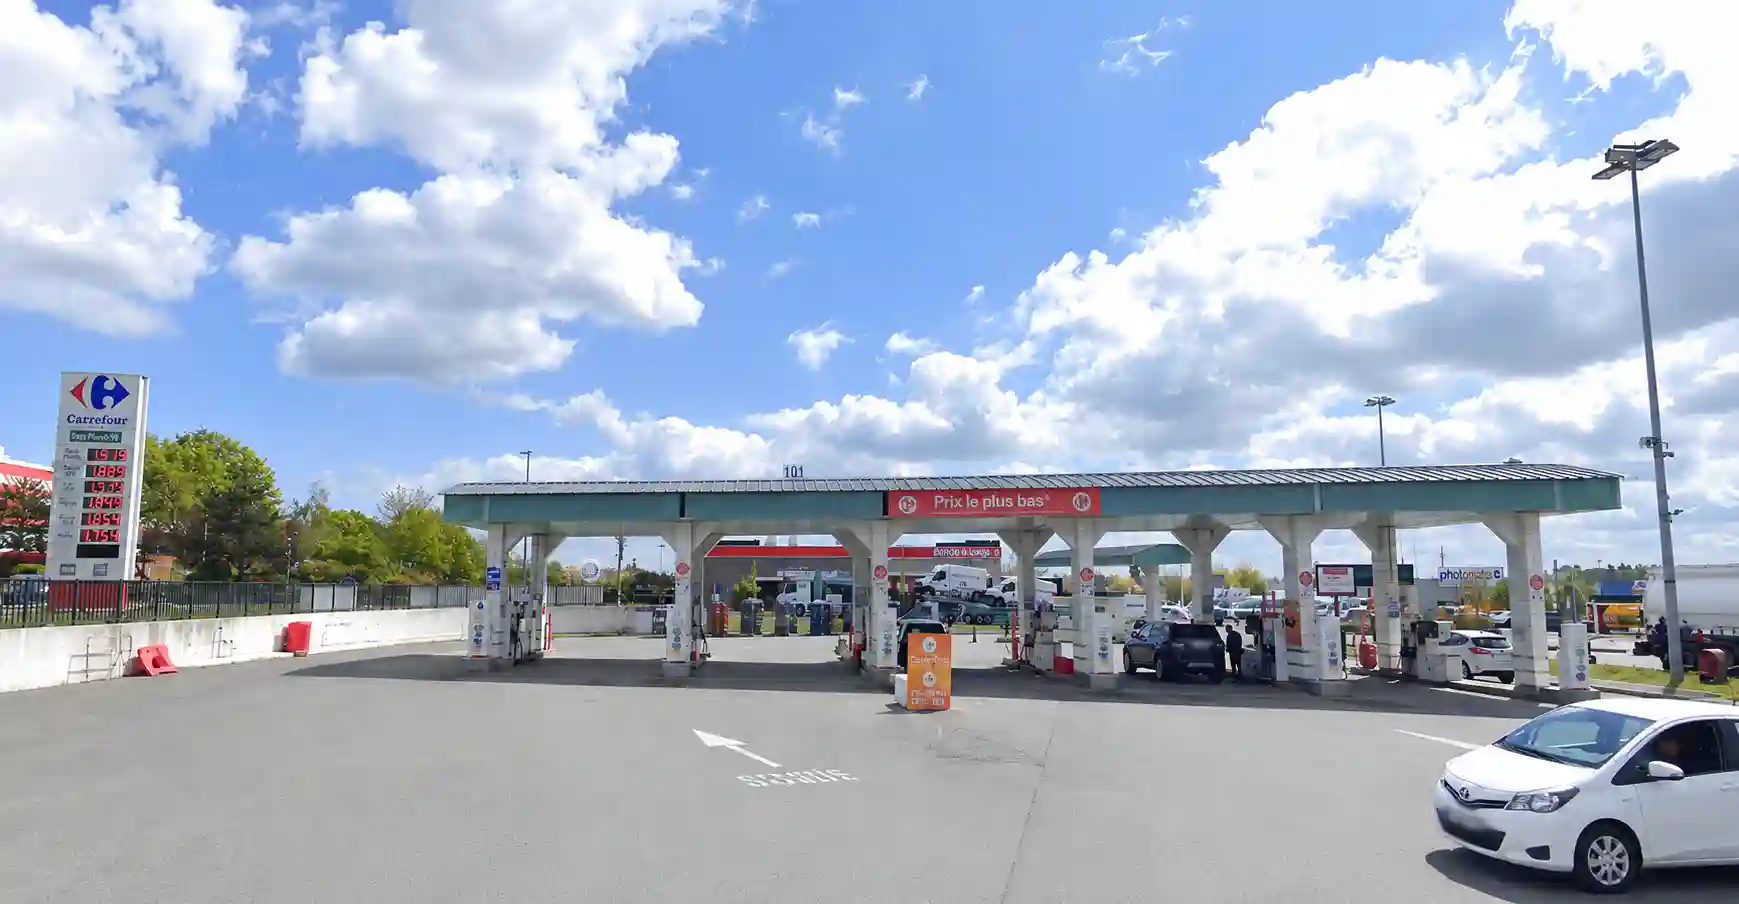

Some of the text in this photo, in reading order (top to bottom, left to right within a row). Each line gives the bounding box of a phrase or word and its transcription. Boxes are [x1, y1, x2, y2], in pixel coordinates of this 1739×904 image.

[67, 413, 129, 426] Carrefour
[783, 465, 804, 478] 101
[934, 495, 963, 509] Prix
[966, 494, 978, 508] le
[982, 494, 1013, 511] plus
